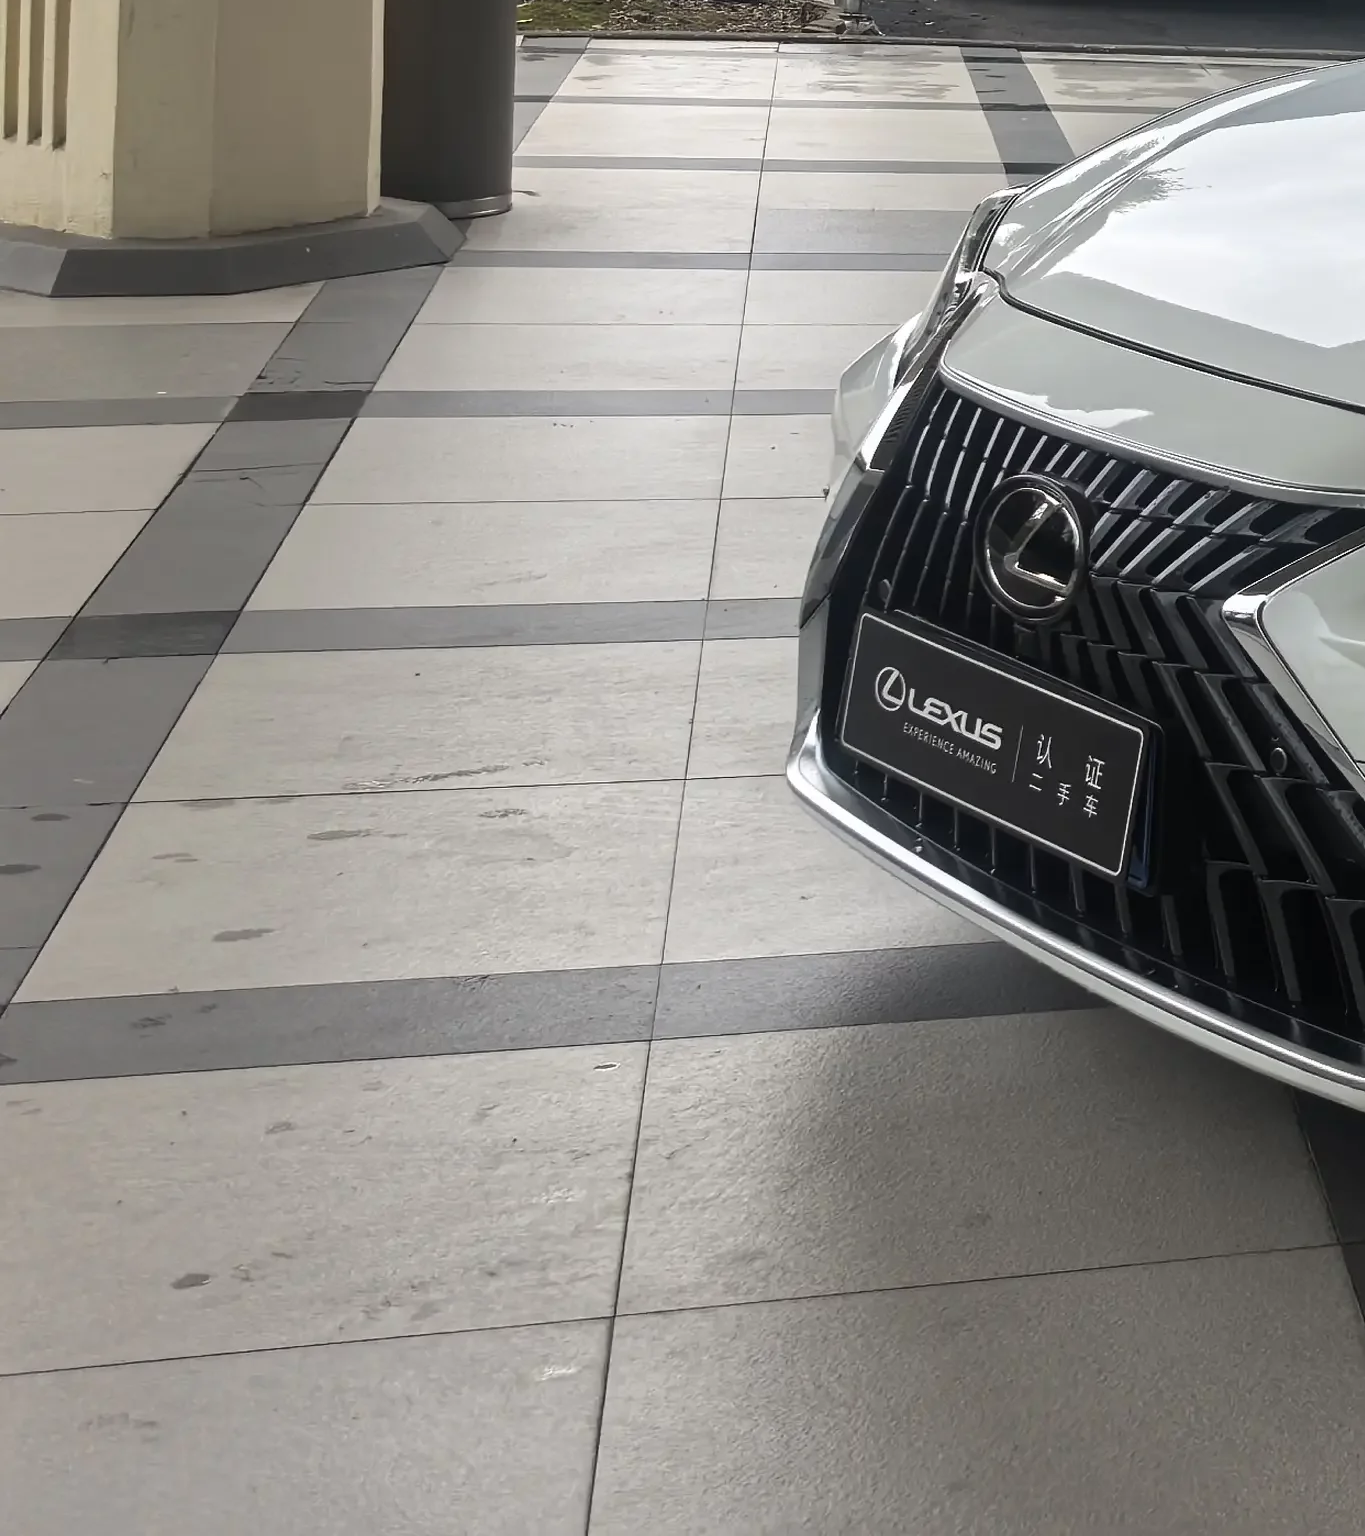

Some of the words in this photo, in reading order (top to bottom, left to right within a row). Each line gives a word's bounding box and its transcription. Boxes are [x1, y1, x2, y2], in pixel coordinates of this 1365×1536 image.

[908, 687, 1003, 750] LEXUS
[903, 722, 954, 755] EXPERIENCE
[956, 747, 997, 775] AMAZING
